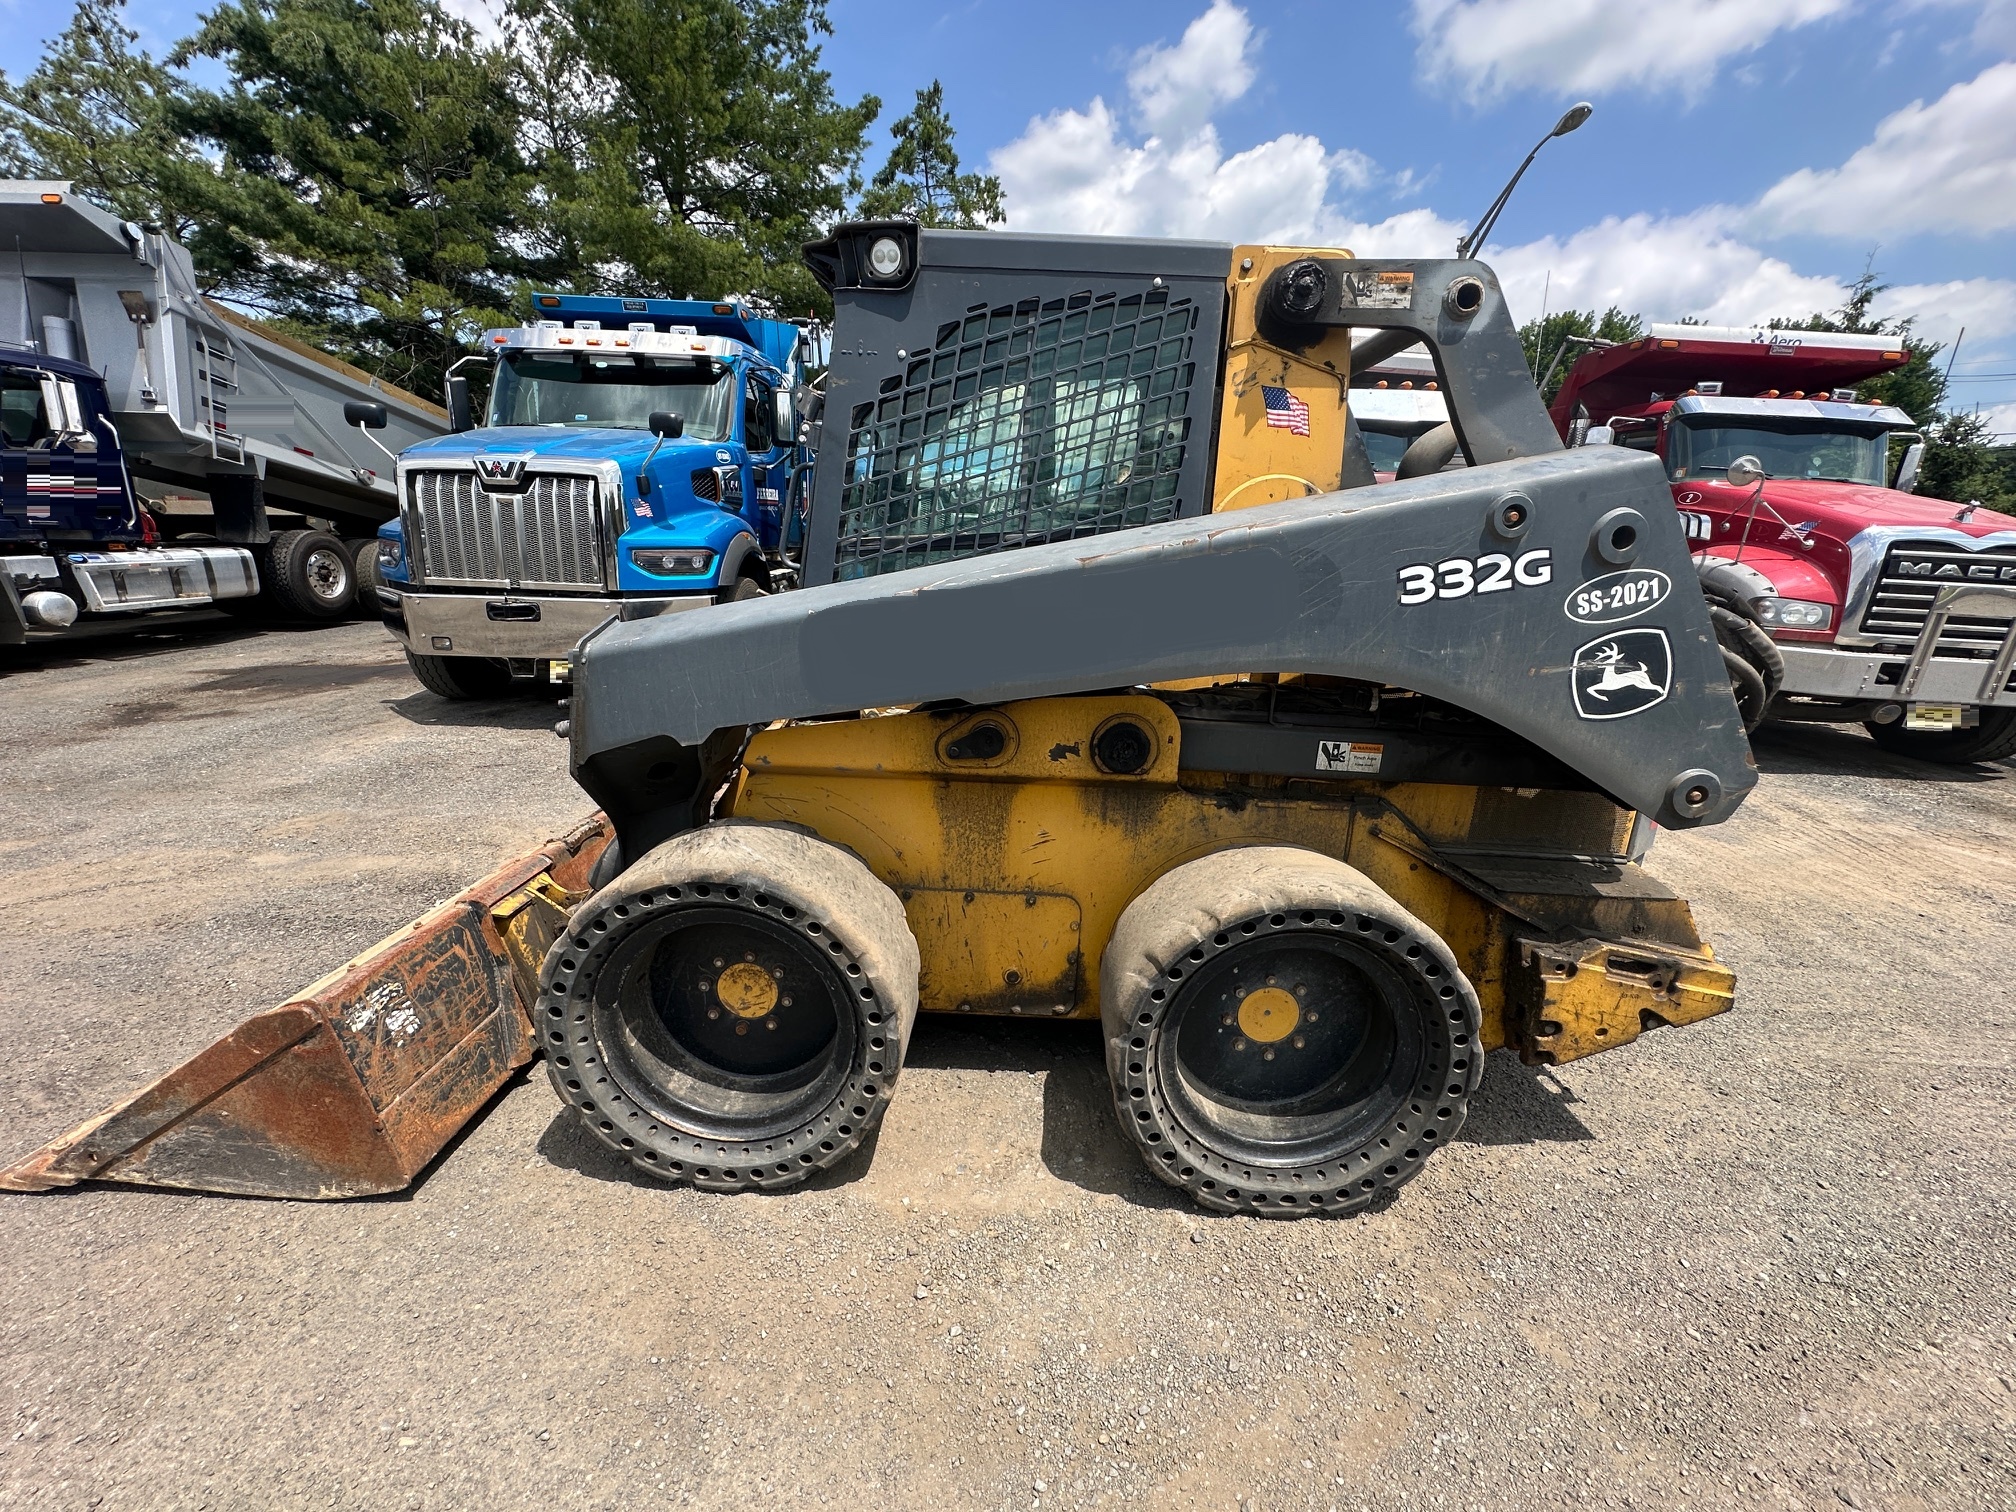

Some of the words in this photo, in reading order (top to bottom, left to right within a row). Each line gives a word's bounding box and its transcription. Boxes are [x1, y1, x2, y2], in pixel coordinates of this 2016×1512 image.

[1685, 492, 1695, 504] 2
[1398, 548, 1553, 606] 332G
[1576, 577, 1660, 616] SS-2021
